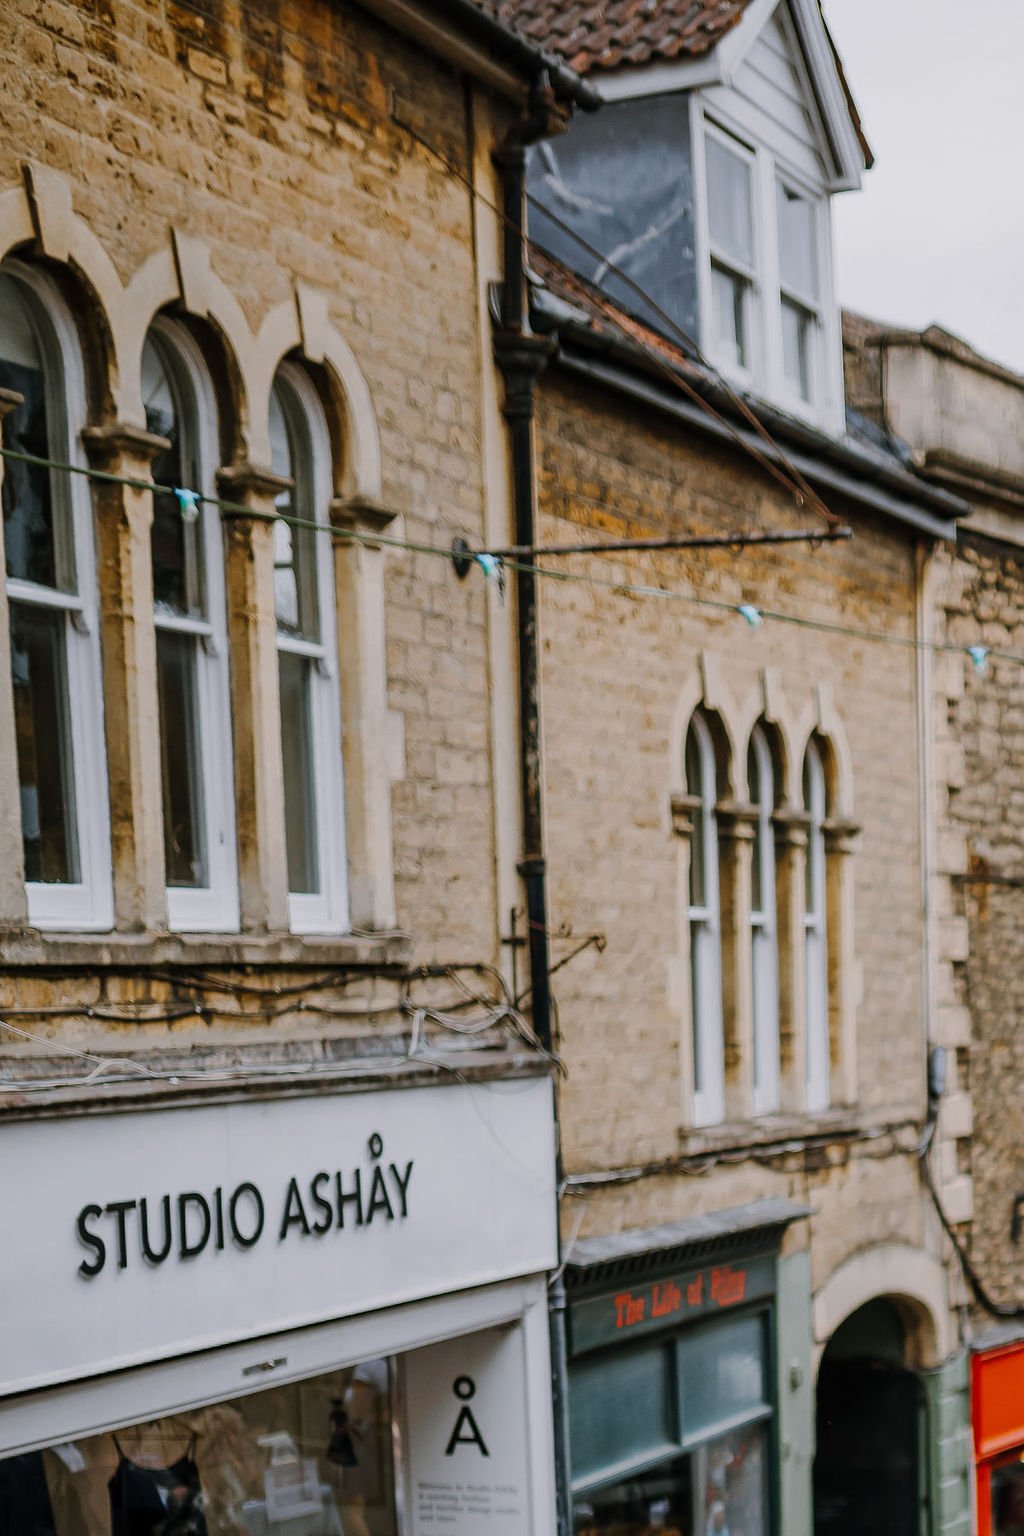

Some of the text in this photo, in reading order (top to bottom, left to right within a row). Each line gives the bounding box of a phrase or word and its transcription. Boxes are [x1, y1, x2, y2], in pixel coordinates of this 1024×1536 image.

[76, 1182, 265, 1277] STUDIO
[614, 1291, 645, 1329] The
[652, 1280, 682, 1319] Life
[687, 1271, 704, 1307] of
